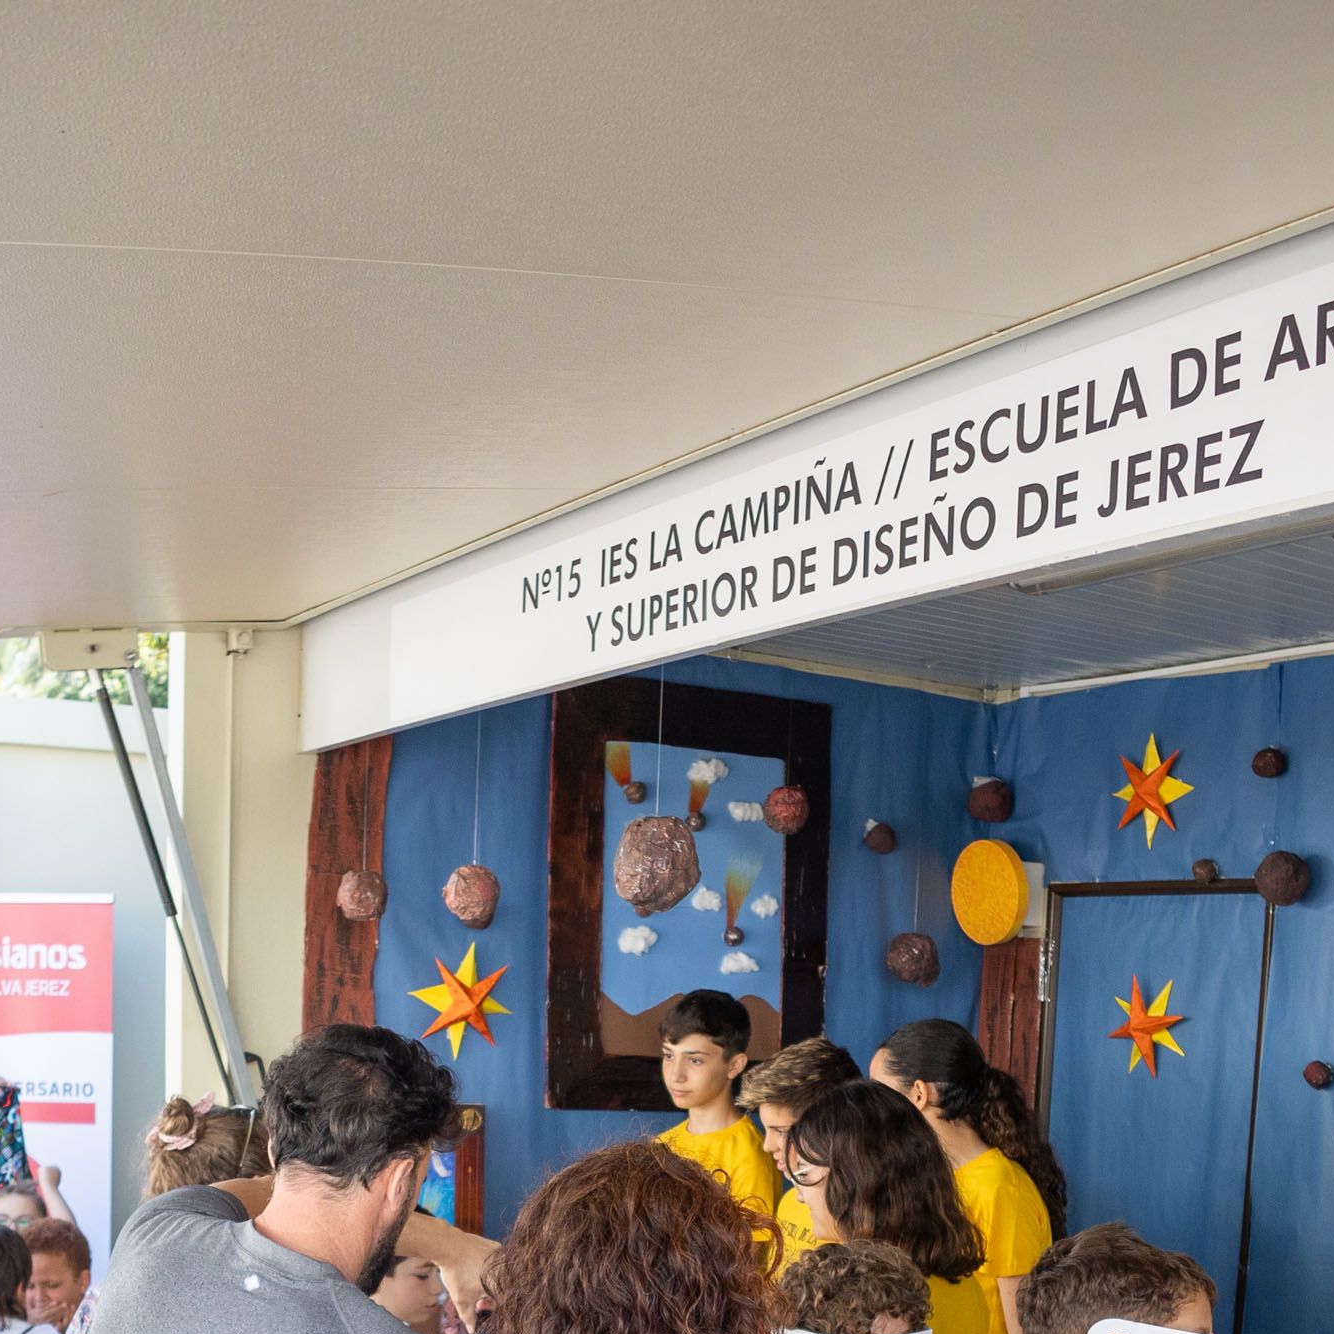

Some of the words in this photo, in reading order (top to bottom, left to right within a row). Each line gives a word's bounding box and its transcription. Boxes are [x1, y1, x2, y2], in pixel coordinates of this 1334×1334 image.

[522, 558, 581, 613] Nº15
[599, 537, 638, 588] IES
[649, 523, 683, 572] LA
[694, 457, 862, 555] CAMPIÑA
[874, 439, 914, 506] //
[929, 366, 1148, 482] ESCUELA
[1170, 330, 1242, 410] DE
[586, 611, 602, 652] Y
[610, 565, 758, 647] SUPERIOR
[772, 546, 817, 603] DE
[832, 492, 996, 587] DISEÑO
[1016, 470, 1079, 539] DE
[1097, 418, 1265, 518] JEREZ
[24, 978, 71, 997] JEREZ
